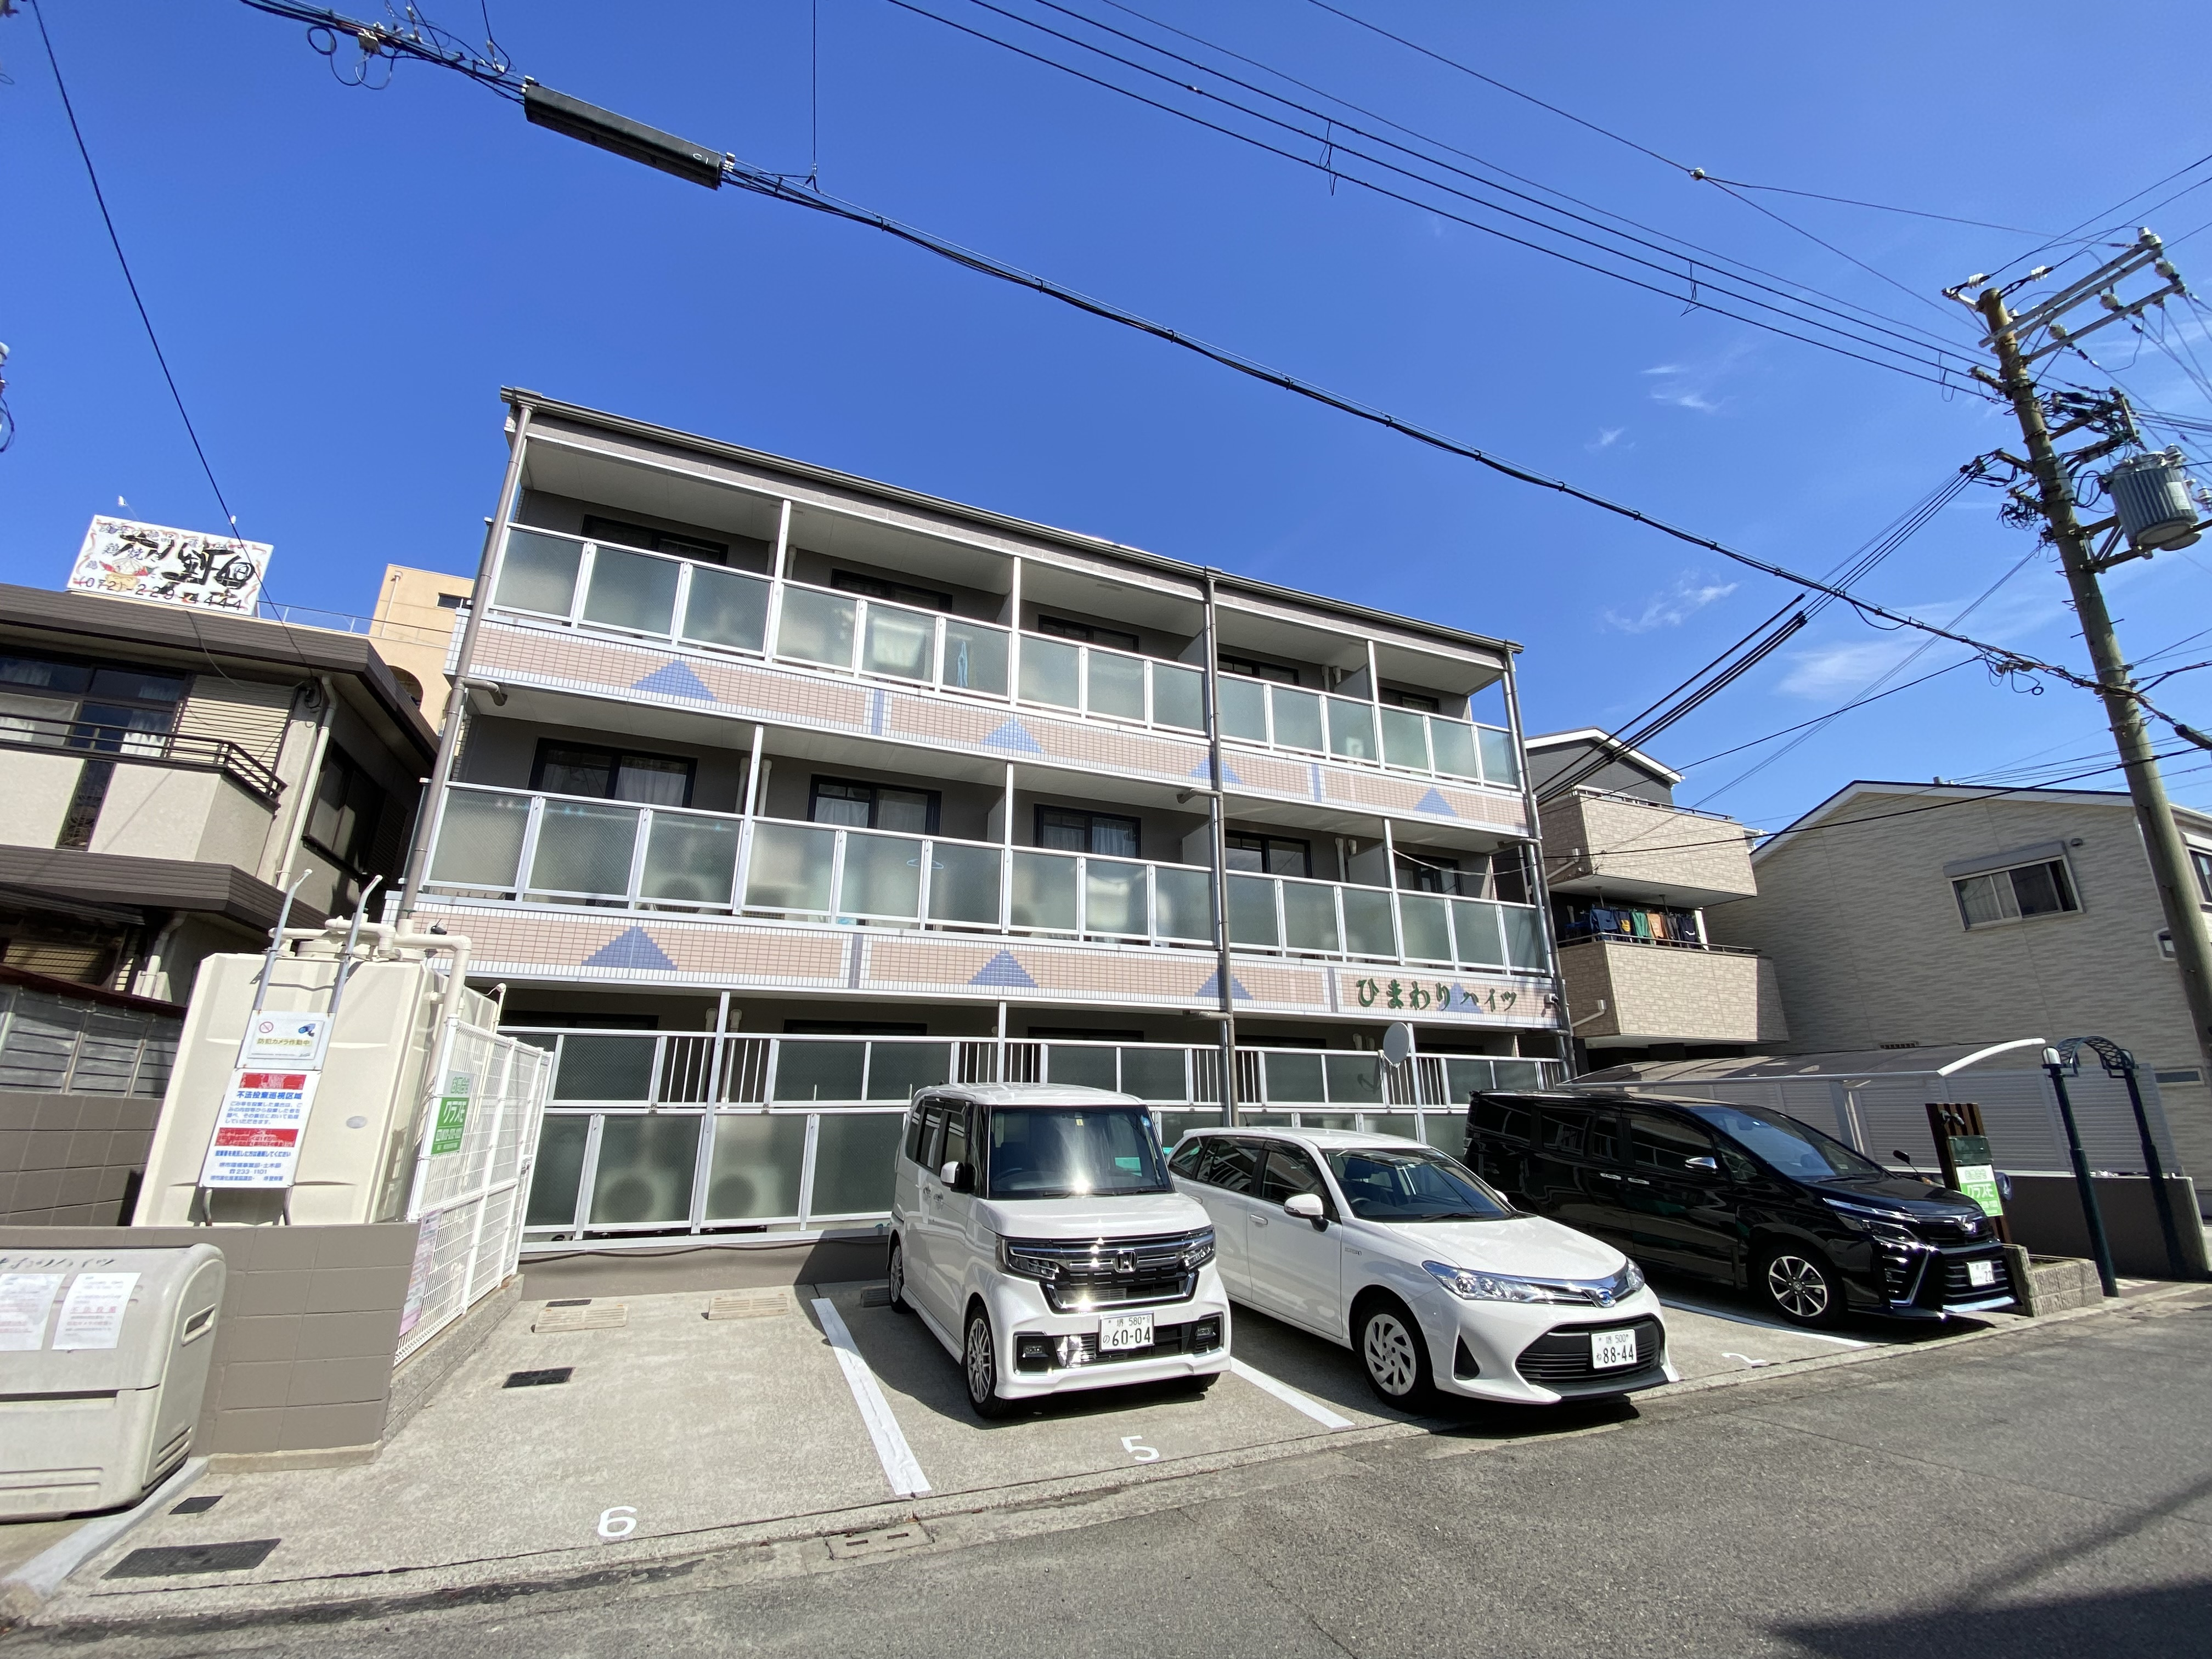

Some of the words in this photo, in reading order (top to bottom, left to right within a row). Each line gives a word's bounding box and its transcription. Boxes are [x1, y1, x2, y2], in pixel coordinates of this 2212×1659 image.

[1356, 978, 1517, 1012] ひまわりハイツ
[443, 1101, 467, 1124] クラスモ
[1129, 1317, 1142, 1326] 580
[1103, 1335, 1110, 1344] の
[1112, 1327, 1151, 1346] 60-04
[1615, 1334, 1626, 1343] 500
[1604, 1344, 1634, 1364] 88-44
[1121, 1435, 1160, 1461] 5
[597, 1505, 637, 1537] 6
